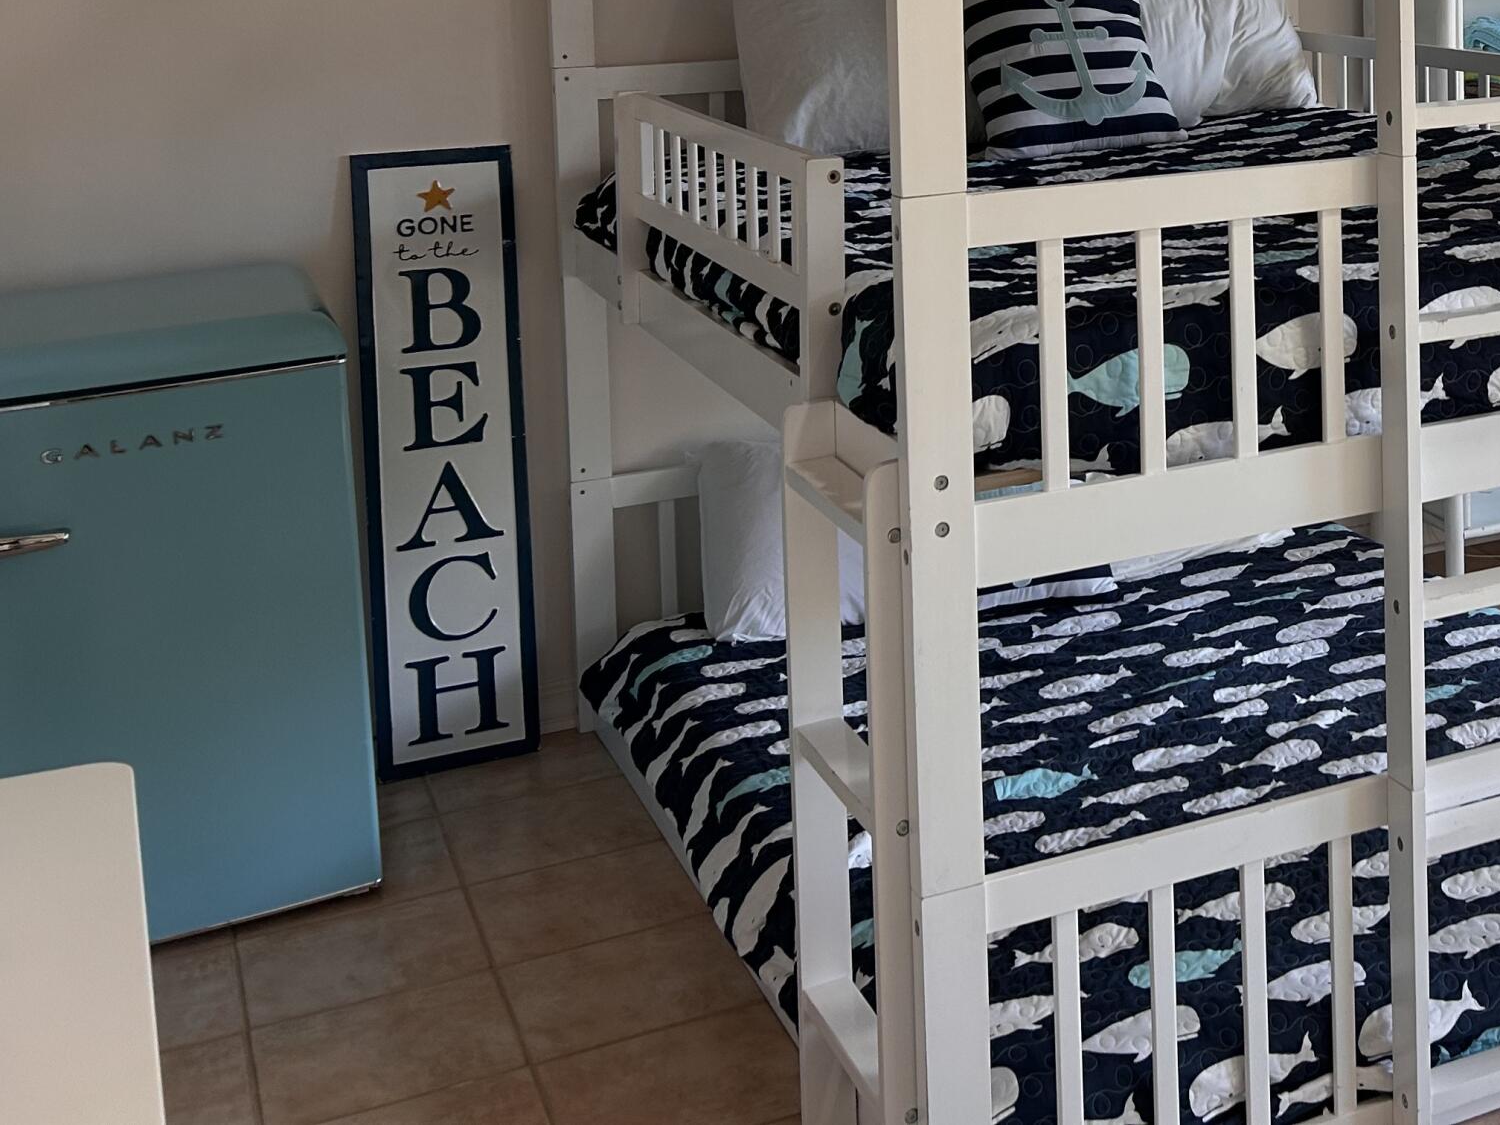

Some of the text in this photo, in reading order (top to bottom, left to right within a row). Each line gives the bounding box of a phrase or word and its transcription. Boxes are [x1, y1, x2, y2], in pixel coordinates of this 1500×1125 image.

[396, 214, 475, 237] GONE
[393, 241, 479, 261] to the
[39, 424, 224, 465] GALANZ
[396, 267, 510, 747] BEACH
